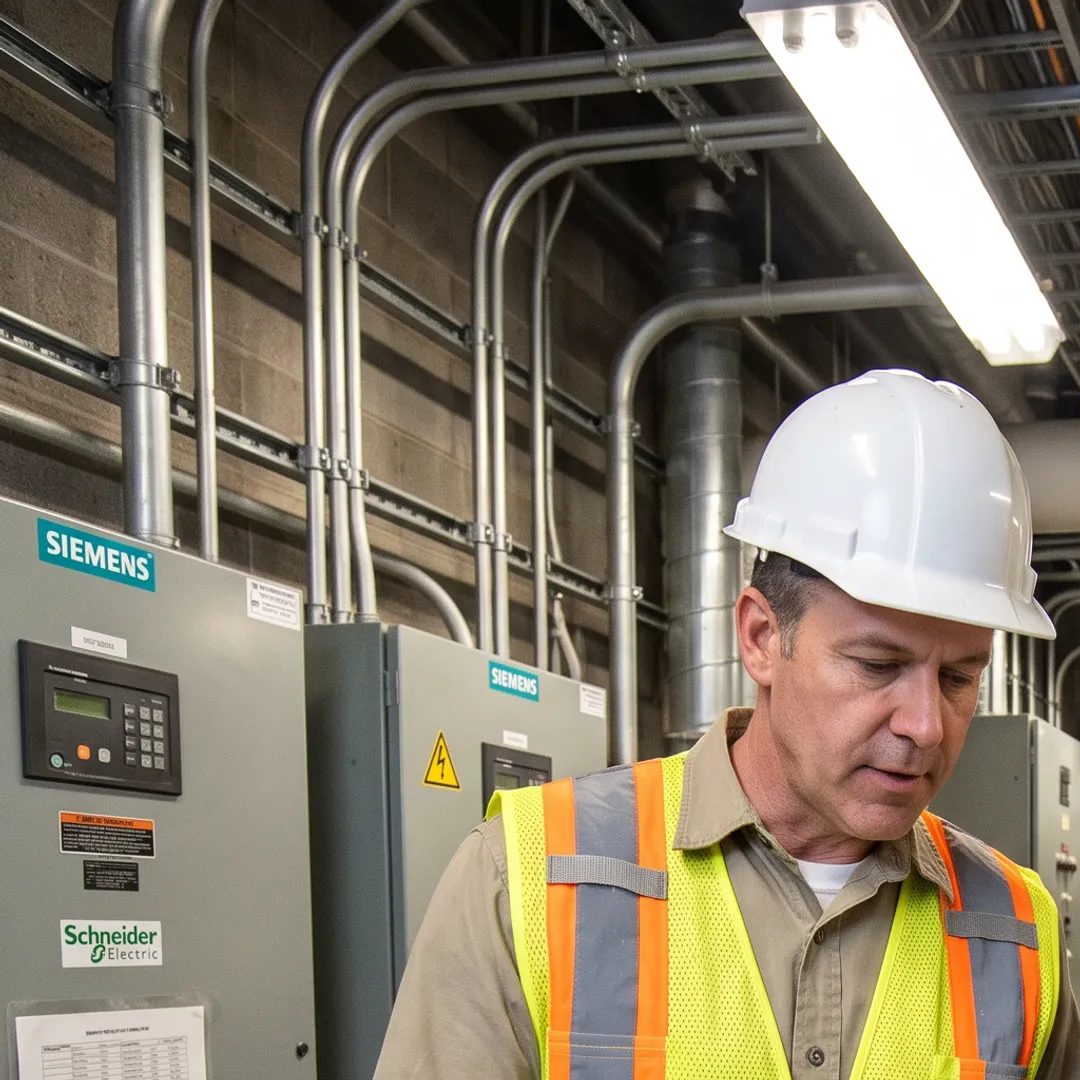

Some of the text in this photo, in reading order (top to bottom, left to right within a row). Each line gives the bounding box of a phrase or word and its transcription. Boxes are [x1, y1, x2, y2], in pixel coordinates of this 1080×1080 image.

[46, 530, 150, 581] SIEMENS
[491, 667, 538, 695] SIEMENS
[64, 924, 157, 945] Schneider
[108, 947, 158, 960] Electric
